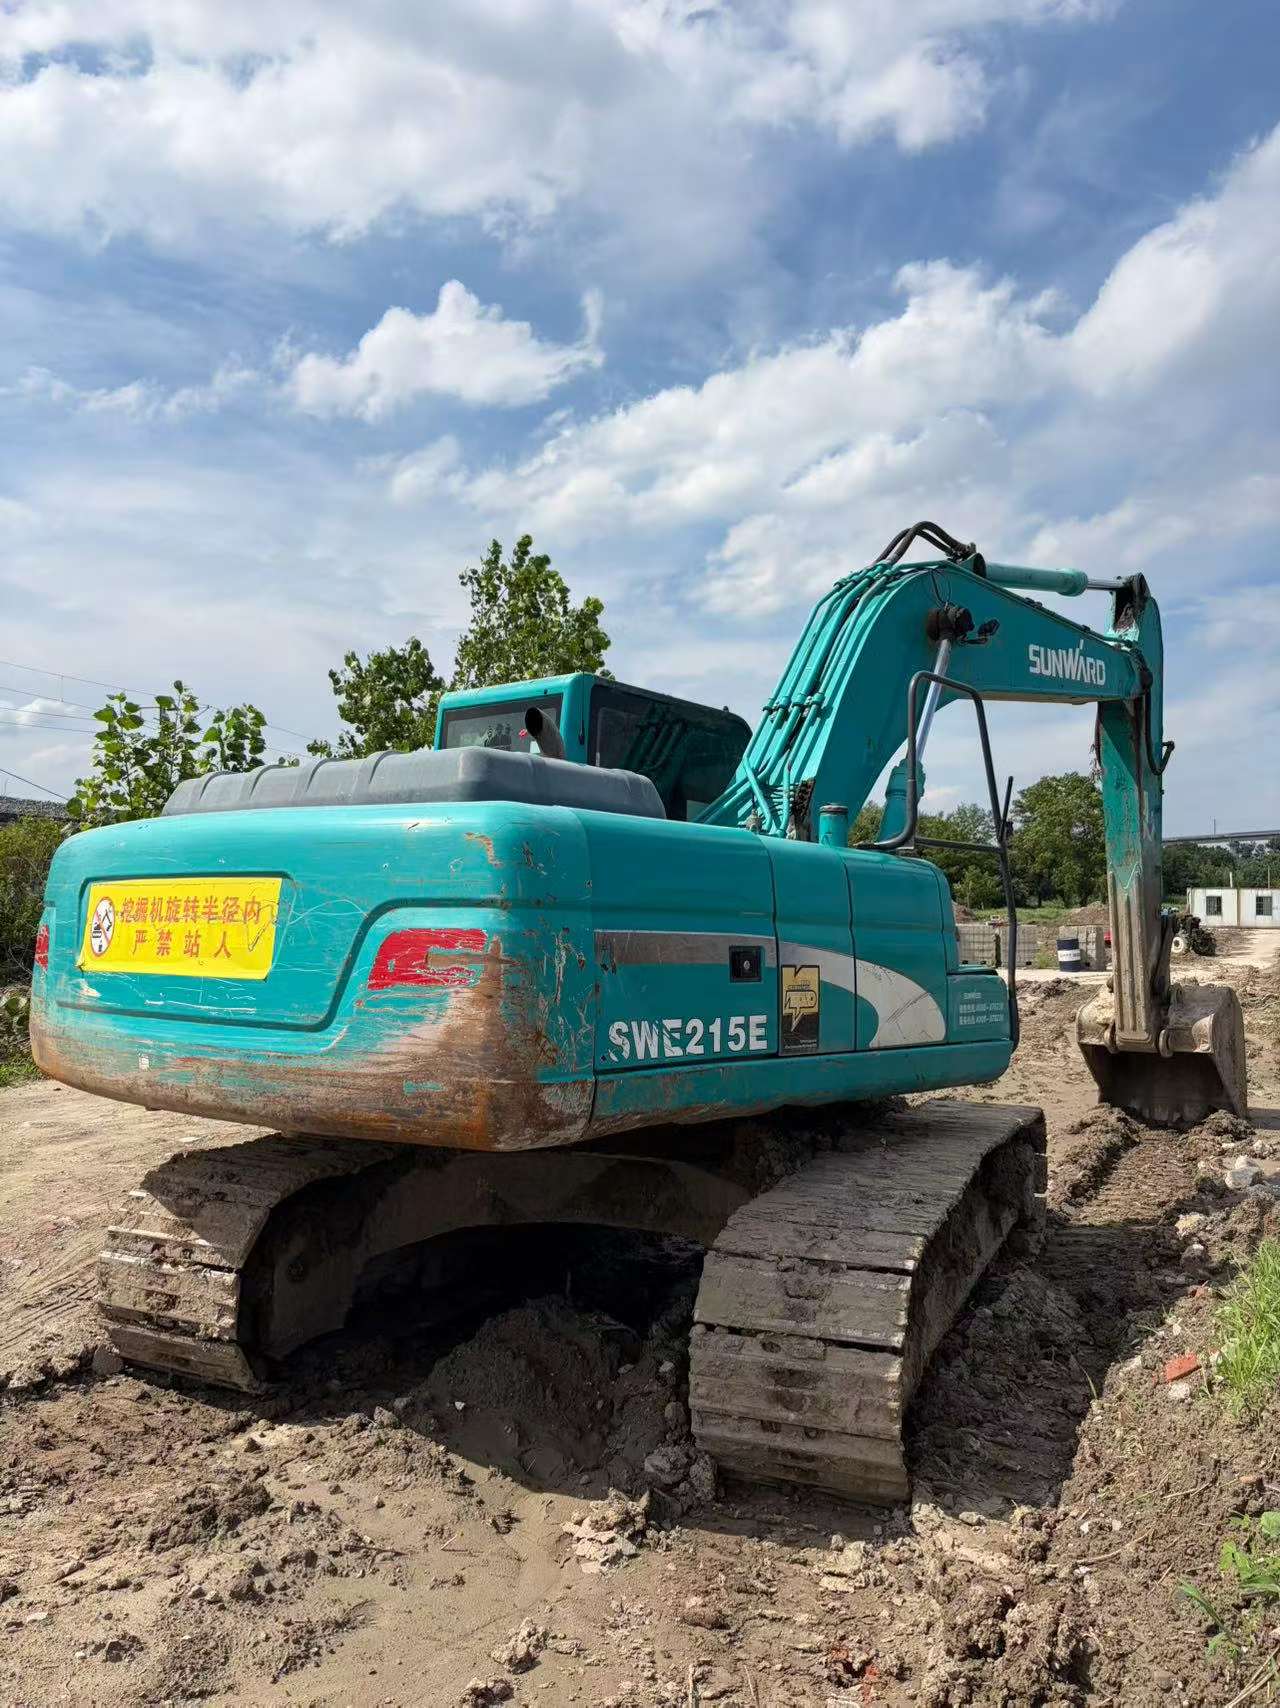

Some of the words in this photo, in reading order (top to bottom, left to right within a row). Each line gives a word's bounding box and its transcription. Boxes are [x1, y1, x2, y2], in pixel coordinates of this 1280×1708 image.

[1028, 639, 1106, 686] SUNWARD
[120, 896, 262, 925] 挖掘机旋转半径内
[132, 928, 233, 959] 严禁站人
[607, 1014, 768, 1062] SWE215E
